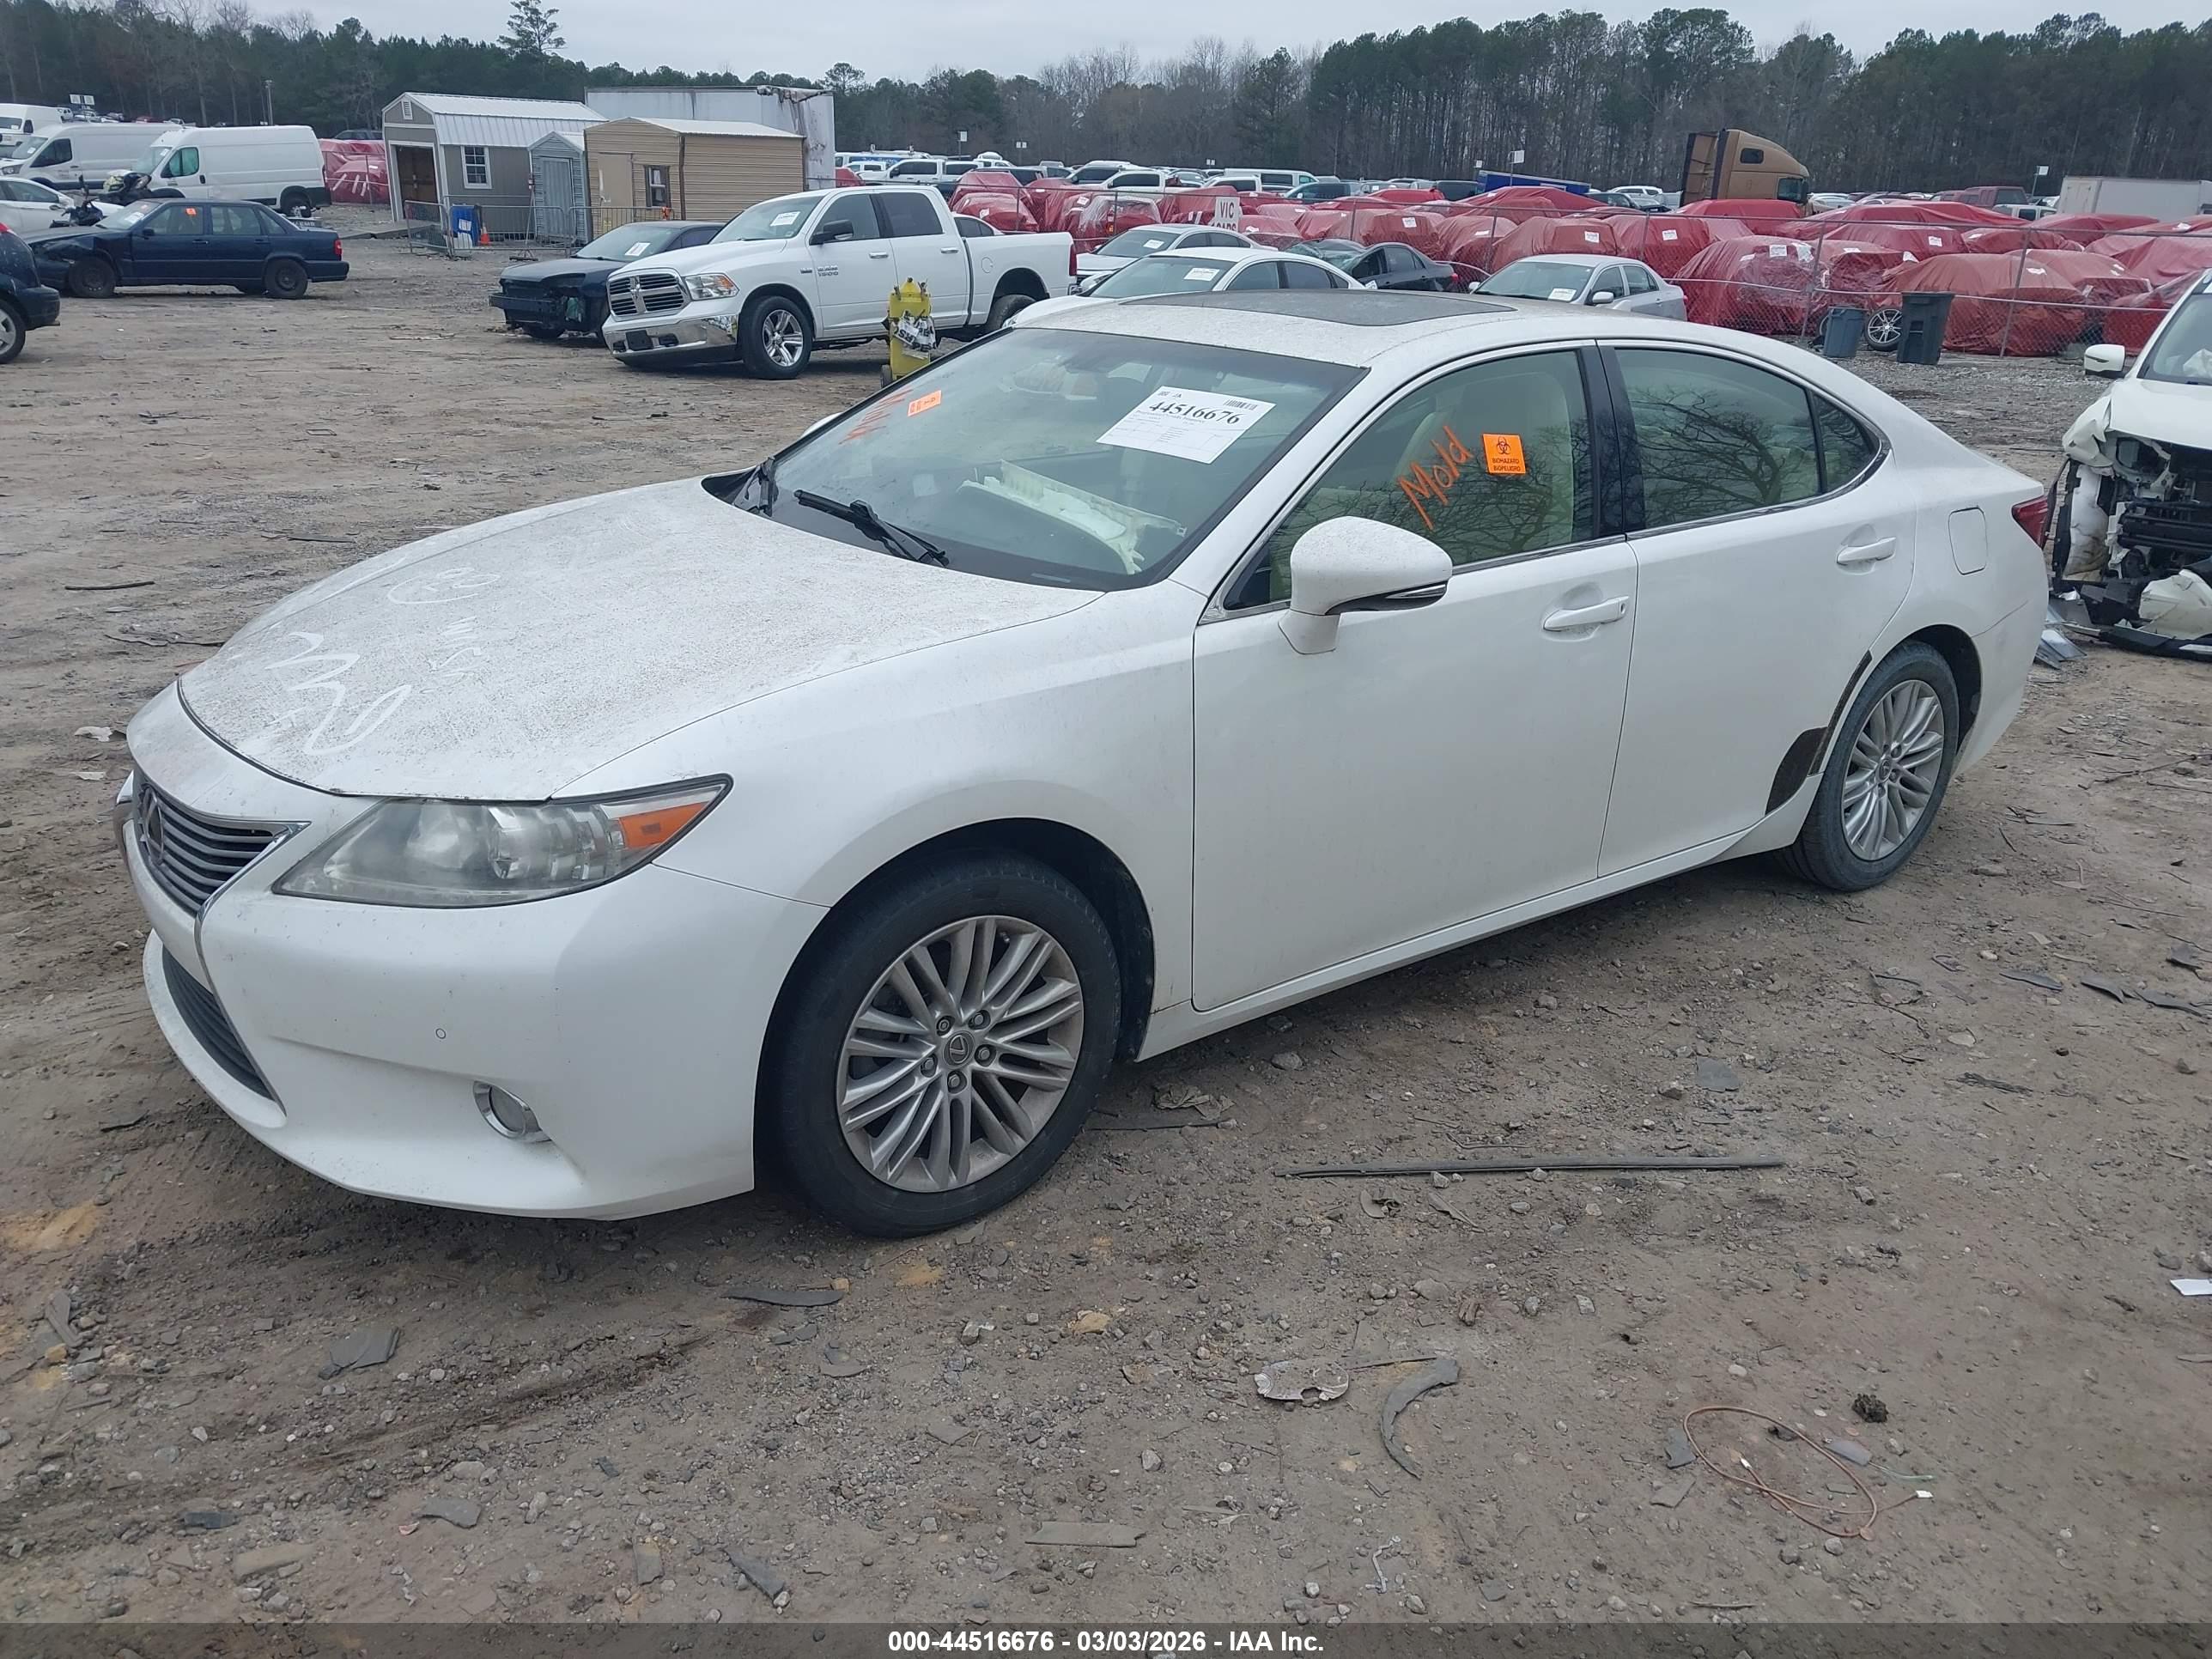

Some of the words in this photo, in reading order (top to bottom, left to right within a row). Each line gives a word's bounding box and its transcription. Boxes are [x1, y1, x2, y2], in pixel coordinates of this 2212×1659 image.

[1220, 202, 1235, 219] VIC
[1149, 401, 1244, 425] 44516676
[1397, 425, 1474, 531] Mold
